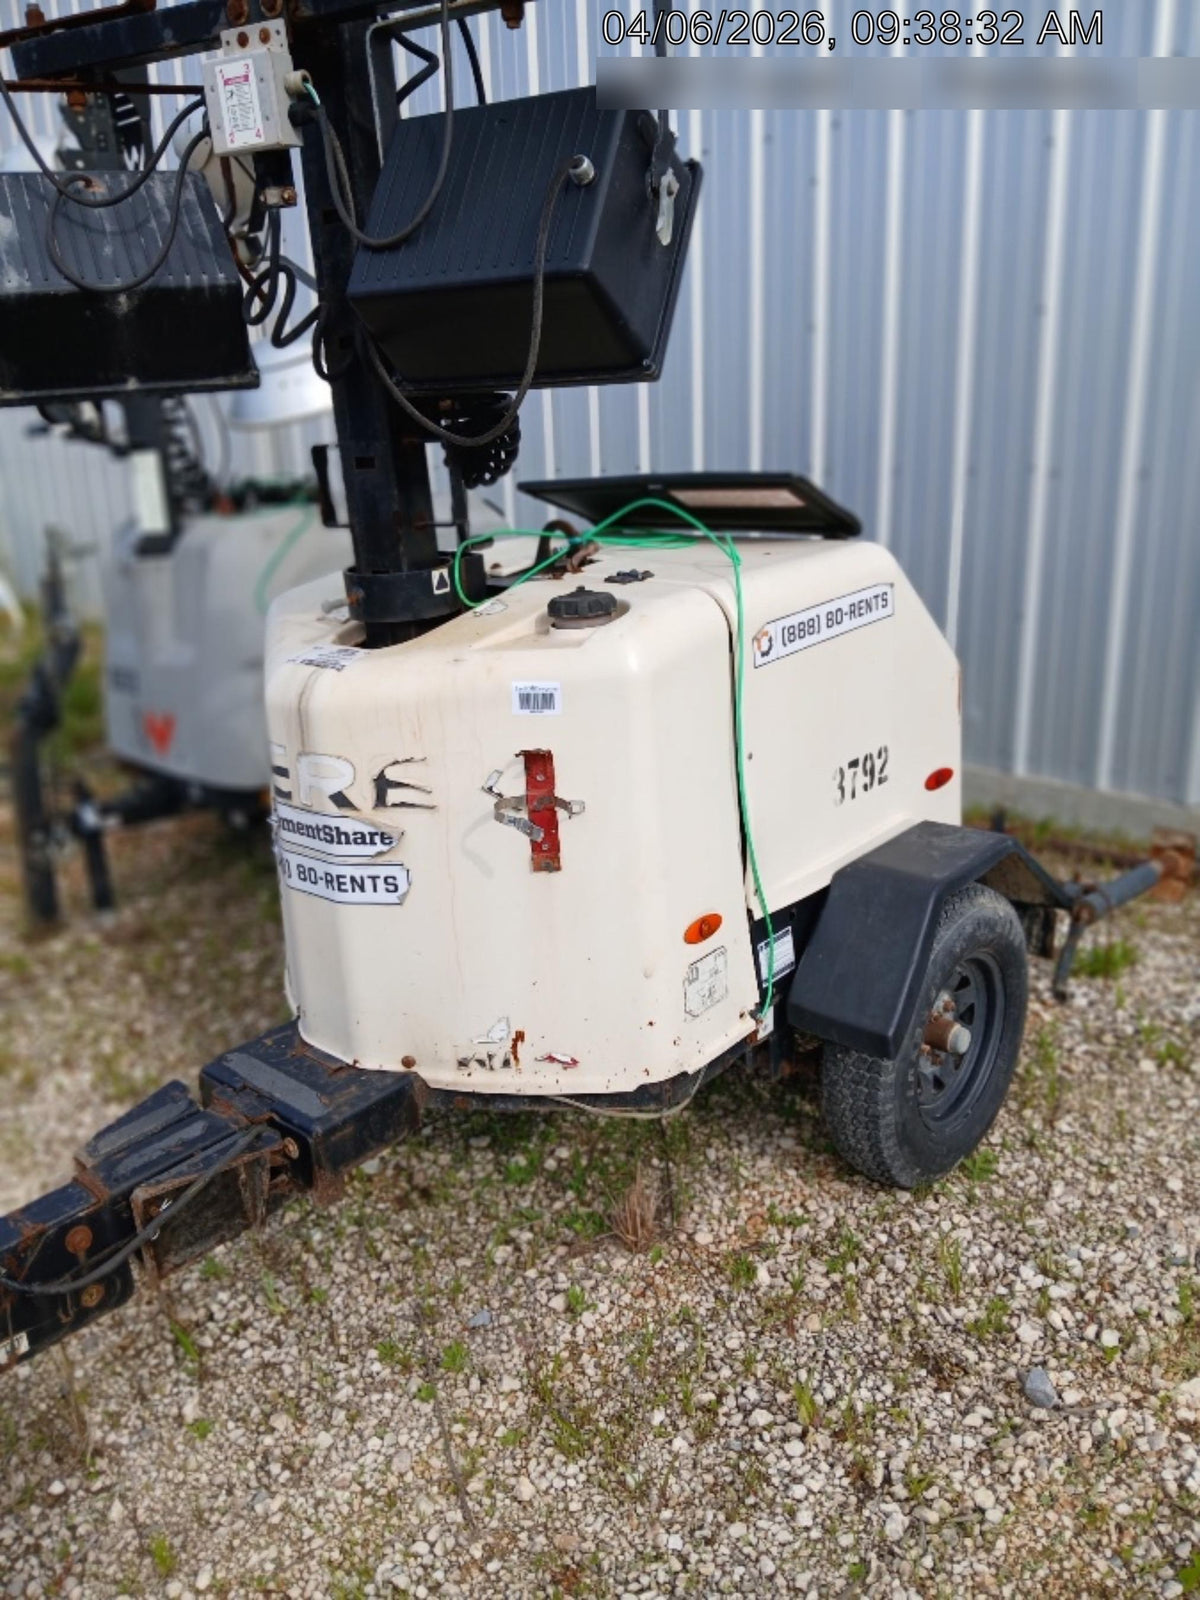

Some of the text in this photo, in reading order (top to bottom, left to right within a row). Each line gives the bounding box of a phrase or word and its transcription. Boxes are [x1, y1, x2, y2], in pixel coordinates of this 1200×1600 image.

[781, 591, 889, 648] (888) 80-RENTS
[279, 817, 394, 846] mentShare
[296, 863, 399, 894] 80-RENTS
